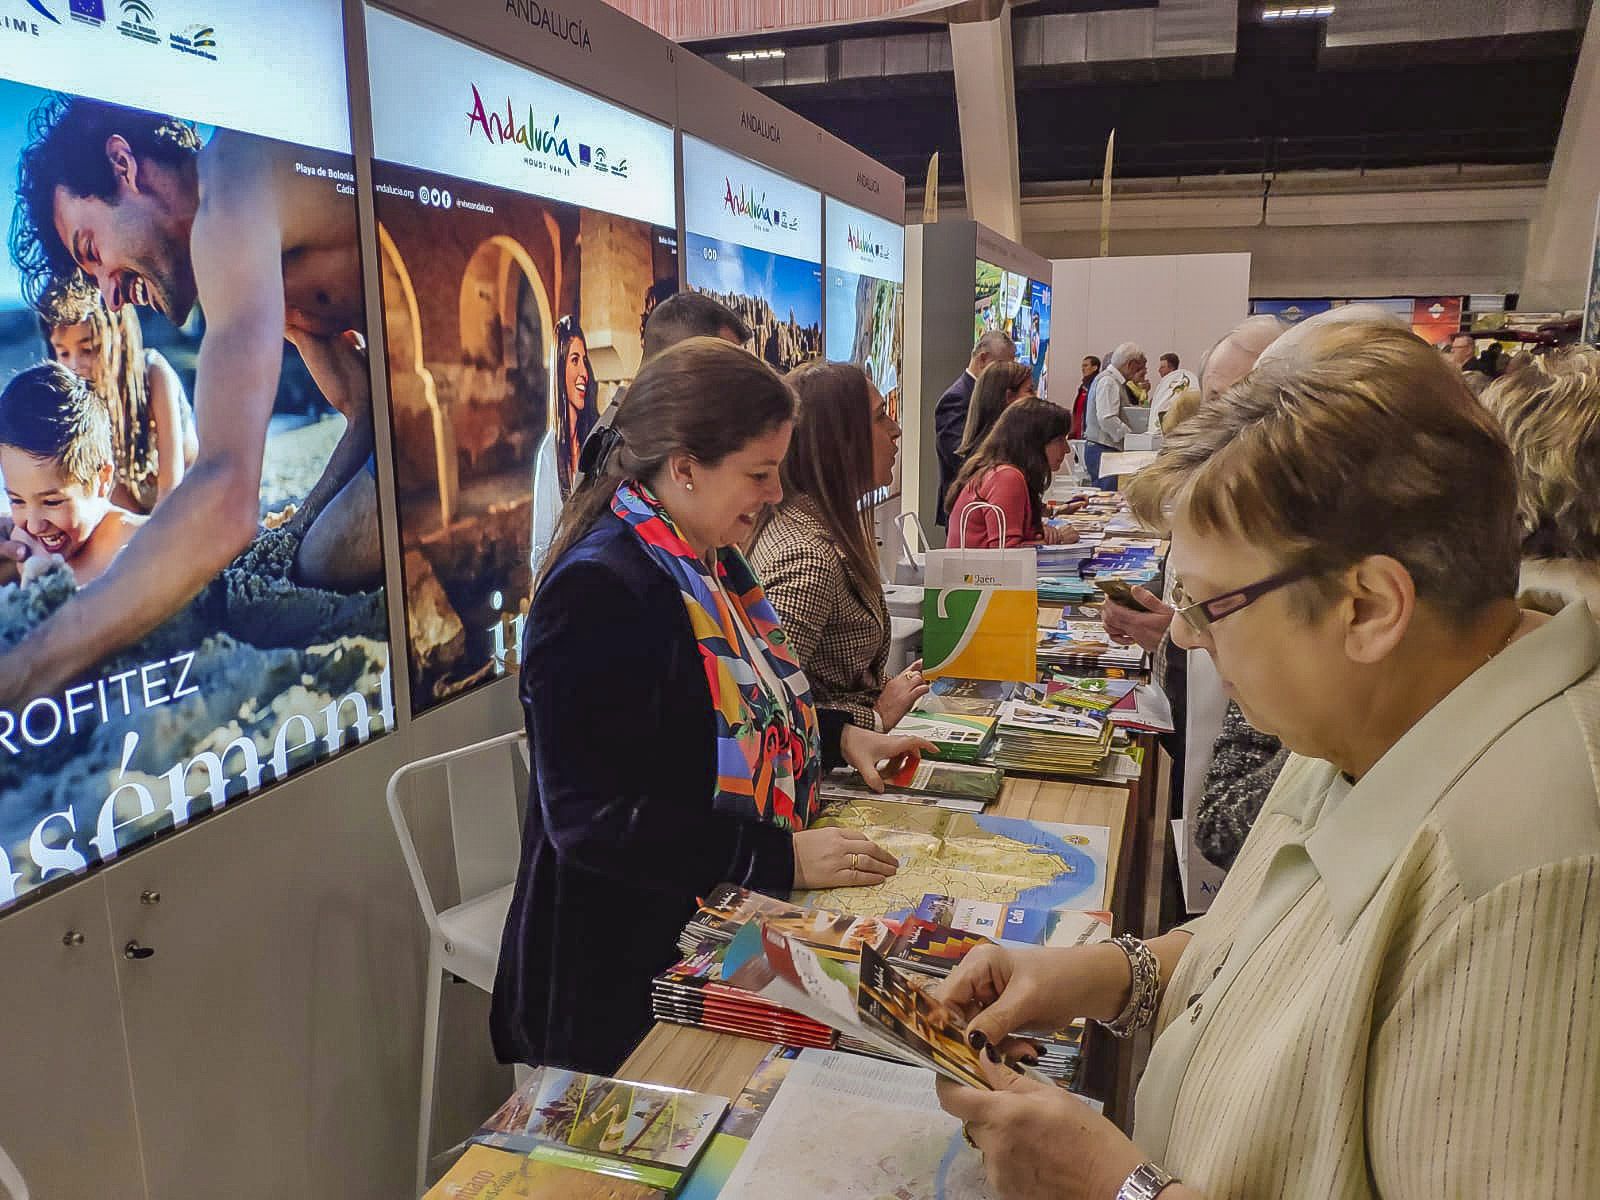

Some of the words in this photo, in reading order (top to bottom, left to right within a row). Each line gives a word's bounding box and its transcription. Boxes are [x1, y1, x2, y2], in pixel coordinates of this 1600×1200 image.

[0, 15, 40, 36] IME
[505, 0, 592, 52] ANDALUCÍA
[466, 82, 577, 168] Andalucía
[295, 162, 316, 176] Playa
